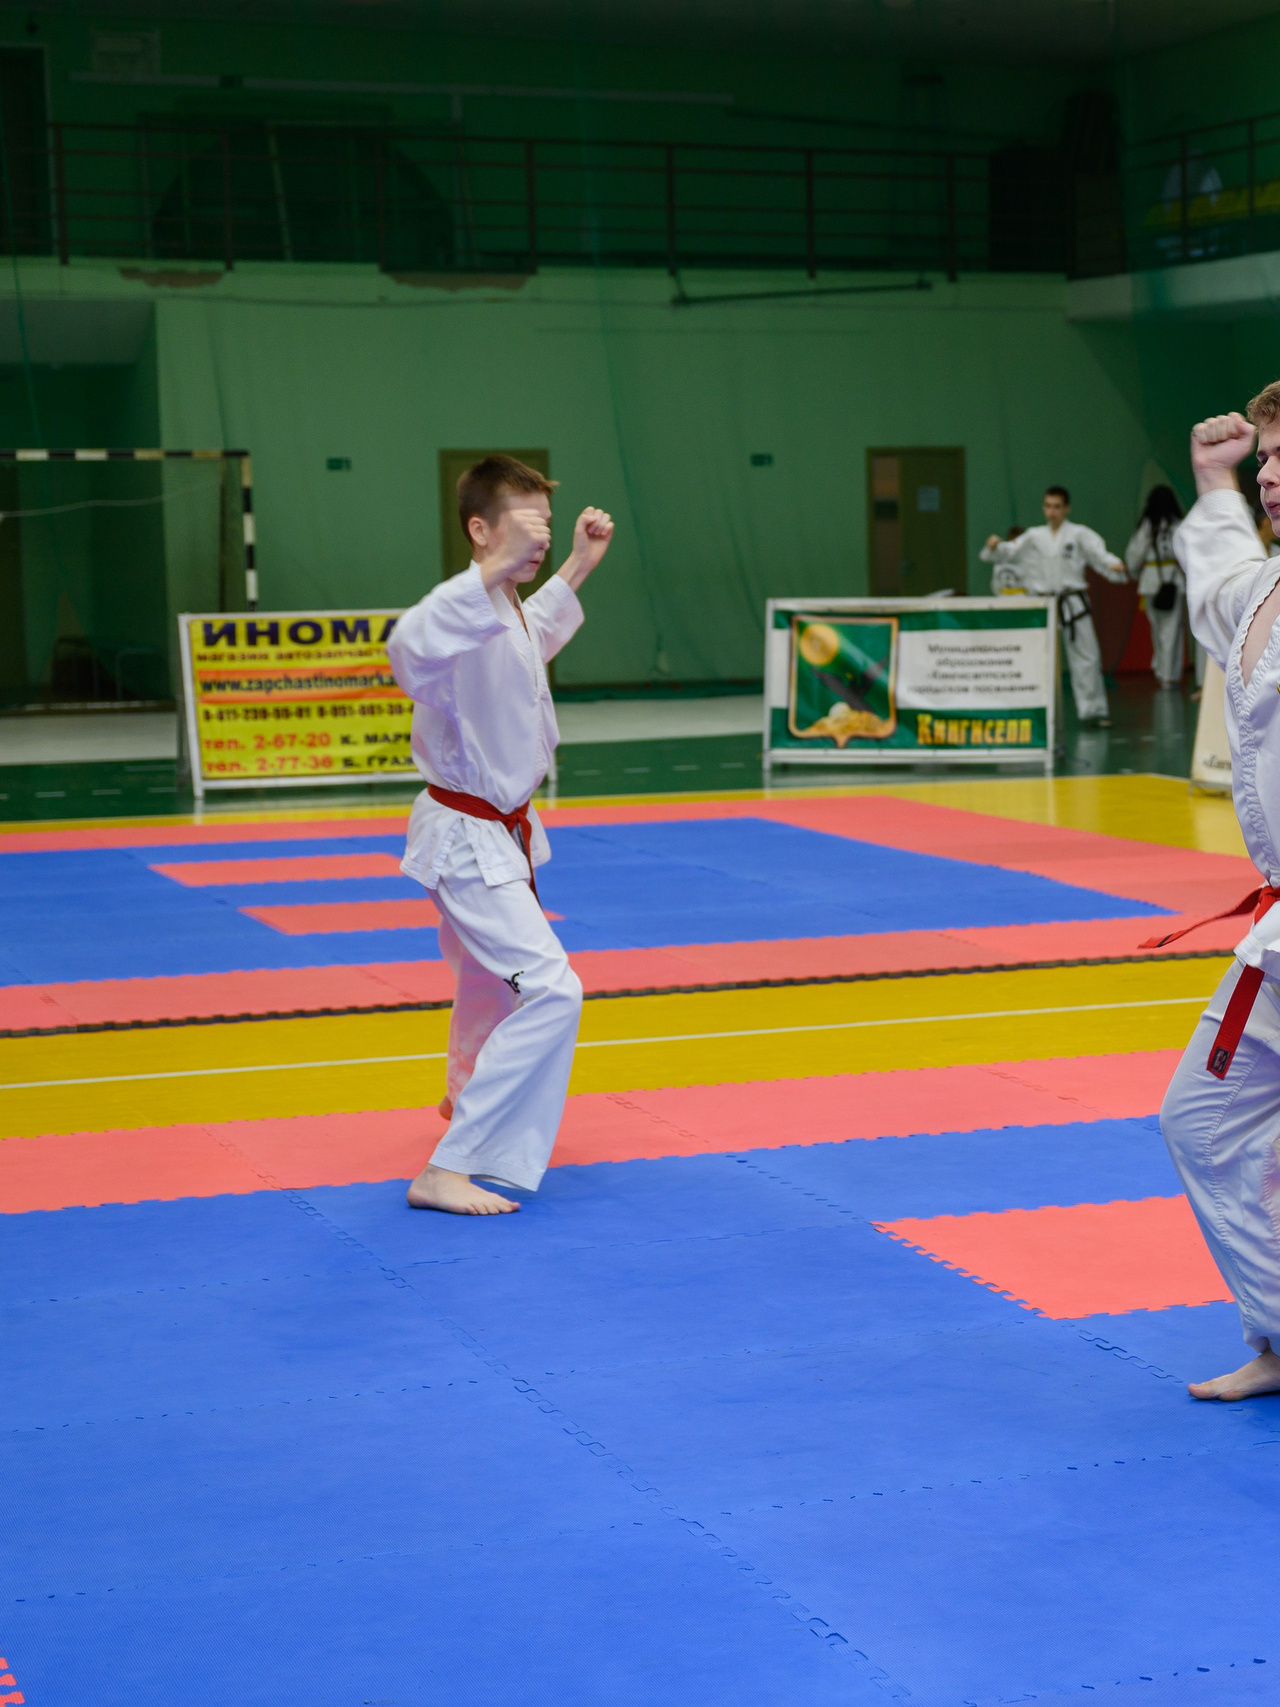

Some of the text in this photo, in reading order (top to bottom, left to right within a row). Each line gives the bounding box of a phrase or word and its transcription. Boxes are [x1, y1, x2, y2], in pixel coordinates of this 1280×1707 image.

[204, 737, 246, 750] тел.
[253, 732, 332, 749] 2-67-20
[206, 760, 248, 773] тел.
[255, 755, 334, 771] 2-77-36
